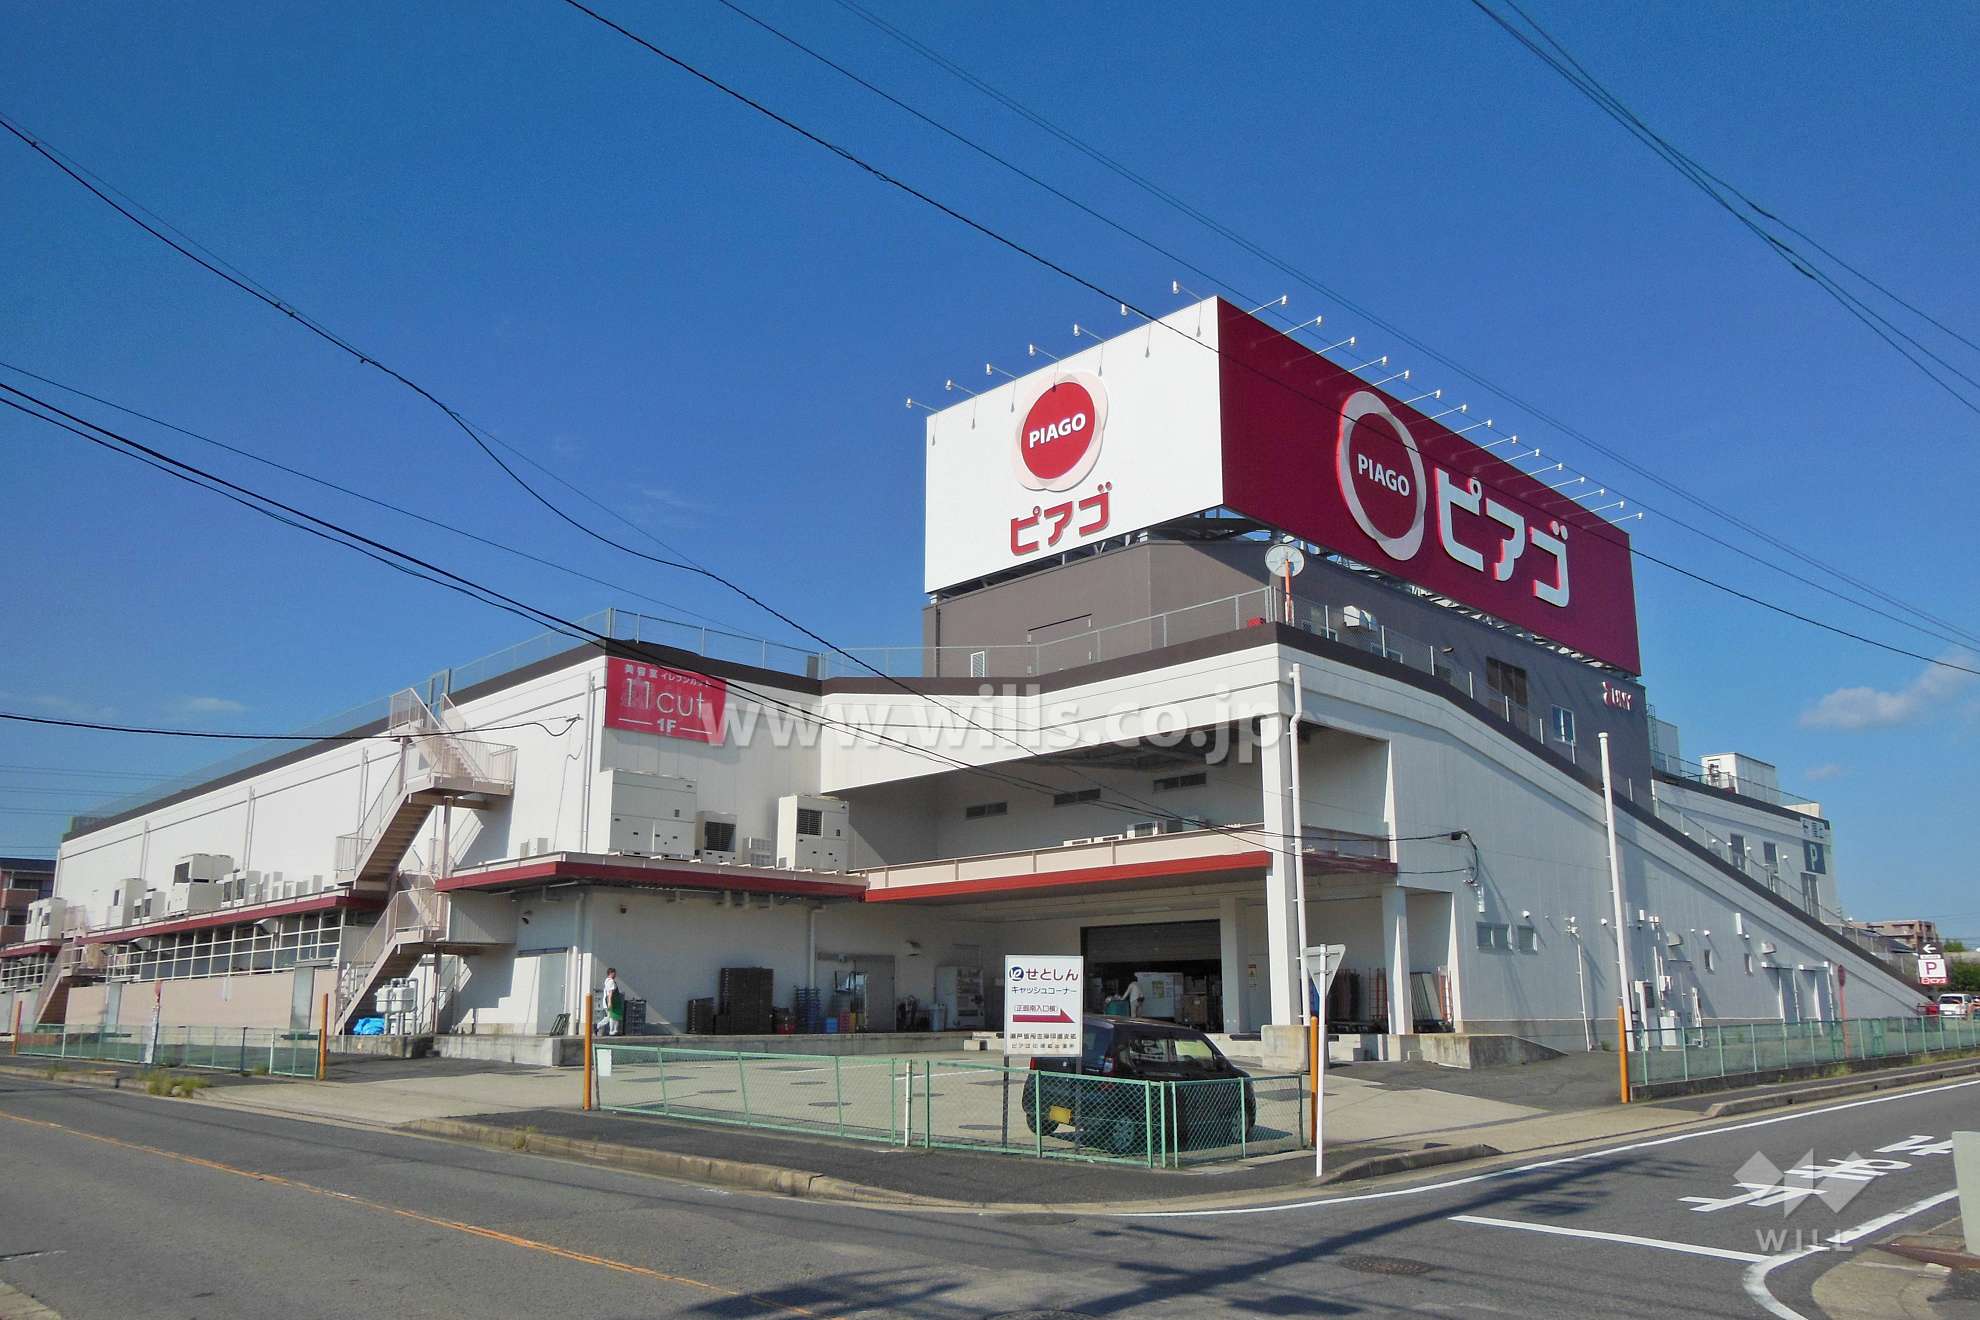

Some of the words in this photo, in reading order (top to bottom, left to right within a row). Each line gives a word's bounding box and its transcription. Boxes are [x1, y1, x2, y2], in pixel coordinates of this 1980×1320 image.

[1029, 412, 1086, 449] PIAGO
[1357, 454, 1411, 498] PIAGO
[1010, 481, 1113, 556] ピアゴ
[1434, 463, 1570, 608] ピアゴ
[657, 718, 677, 733] 1F
[1025, 968, 1079, 981] せとしん
[1925, 961, 1937, 975] P
[1011, 986, 1078, 995] キャッシュコーナー
